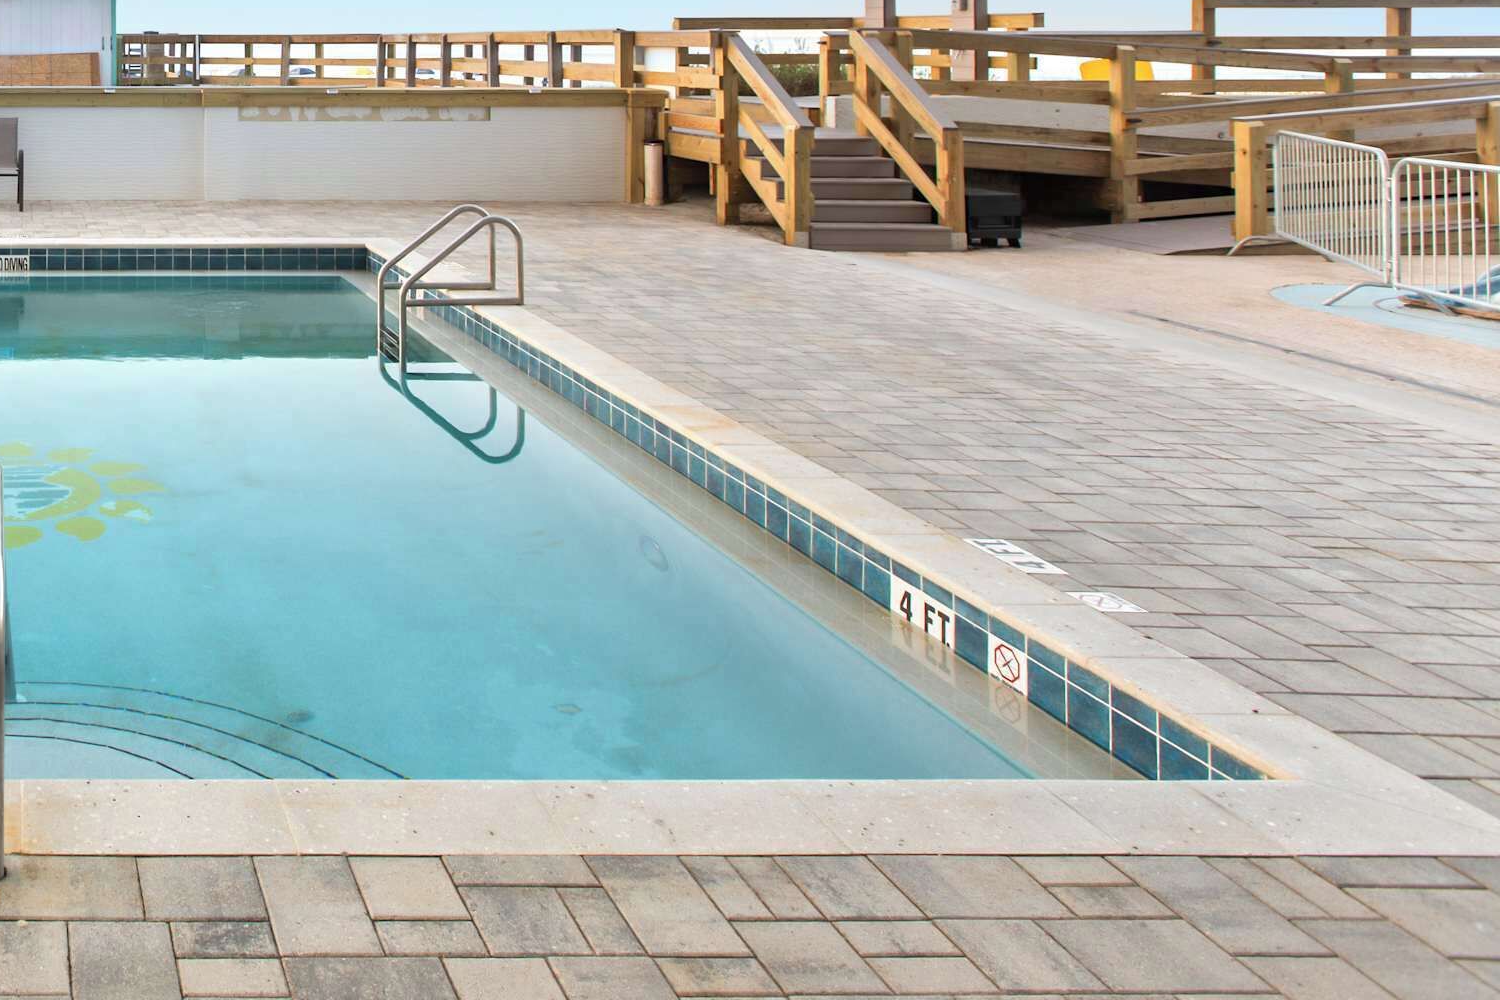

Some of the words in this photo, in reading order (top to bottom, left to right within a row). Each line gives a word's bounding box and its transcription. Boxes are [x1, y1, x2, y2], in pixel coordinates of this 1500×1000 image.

[4, 257, 28, 271] DIVING
[899, 590, 913, 622] 4
[924, 601, 950, 649] FT.
